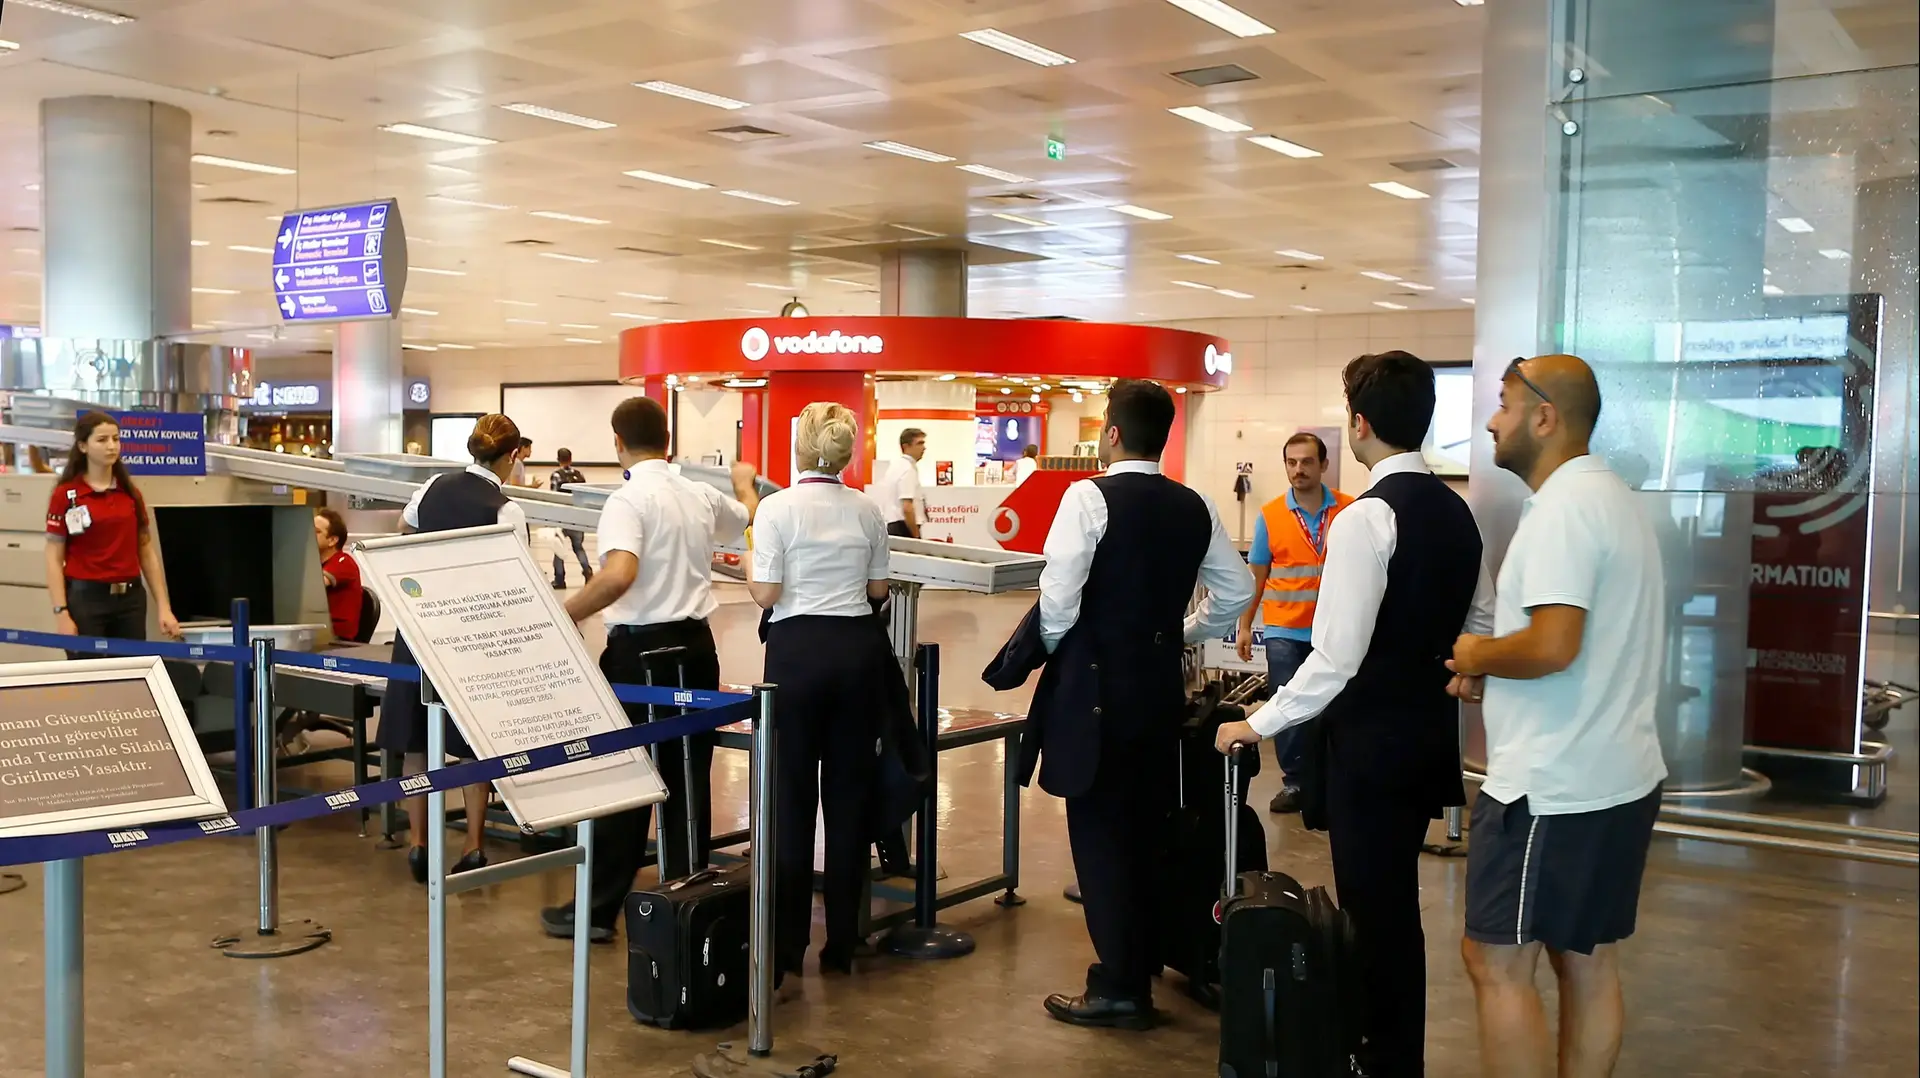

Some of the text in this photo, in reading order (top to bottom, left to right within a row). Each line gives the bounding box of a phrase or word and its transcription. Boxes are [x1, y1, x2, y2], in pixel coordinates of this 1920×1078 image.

[773, 330, 884, 354] vodafone
[132, 429, 159, 440] YATAY
[160, 431, 199, 440] KOYUNUZ
[146, 456, 165, 466] FLAT
[166, 456, 178, 465] ON
[180, 456, 199, 466] BELT
[928, 515, 965, 524] ransferi
[461, 593, 491, 604] KÜLTÜR
[491, 591, 502, 600] VE
[502, 586, 528, 598] TABİAT
[417, 595, 536, 619] VARLIKLARINI KORUMA KANUNU"
[432, 621, 553, 646] KÜLTÜR VE TABİAT VARLIKLARININ
[452, 633, 543, 654] YURTDIŞINA ÇIKARILMASI
[484, 647, 522, 659] YASAKTIR!
[459, 676, 467, 684] IN
[467, 669, 516, 683] ACCORDANCE
[516, 667, 535, 676] WITH
[554, 659, 569, 669] LAW
[465, 668, 575, 693] OF PROTECTION CULTURAL AND
[468, 693, 501, 703] NATURAL
[548, 680, 566, 689] WITH
[567, 676, 582, 685] THE
[506, 696, 537, 707] NUMBER
[45, 707, 161, 726] Güvenliğinden
[491, 712, 602, 740] CULTURAL AND NATURAL ASSETS
[499, 706, 583, 728] IT'S FORBIDDEN TO TAKE
[1, 726, 139, 749] orumlu görevliler
[514, 725, 590, 746] OUT OF THE COUNTRY!
[0, 753, 33, 768] nda
[33, 744, 118, 763] Terminale
[564, 740, 590, 755] TAV
[503, 754, 531, 769] TAV
[1, 761, 152, 786] Girilmesi Yasaktır.
[399, 776, 432, 792] TAV
[325, 791, 360, 806] TAV
[198, 817, 238, 832] TAV
[107, 830, 149, 844] TAV
